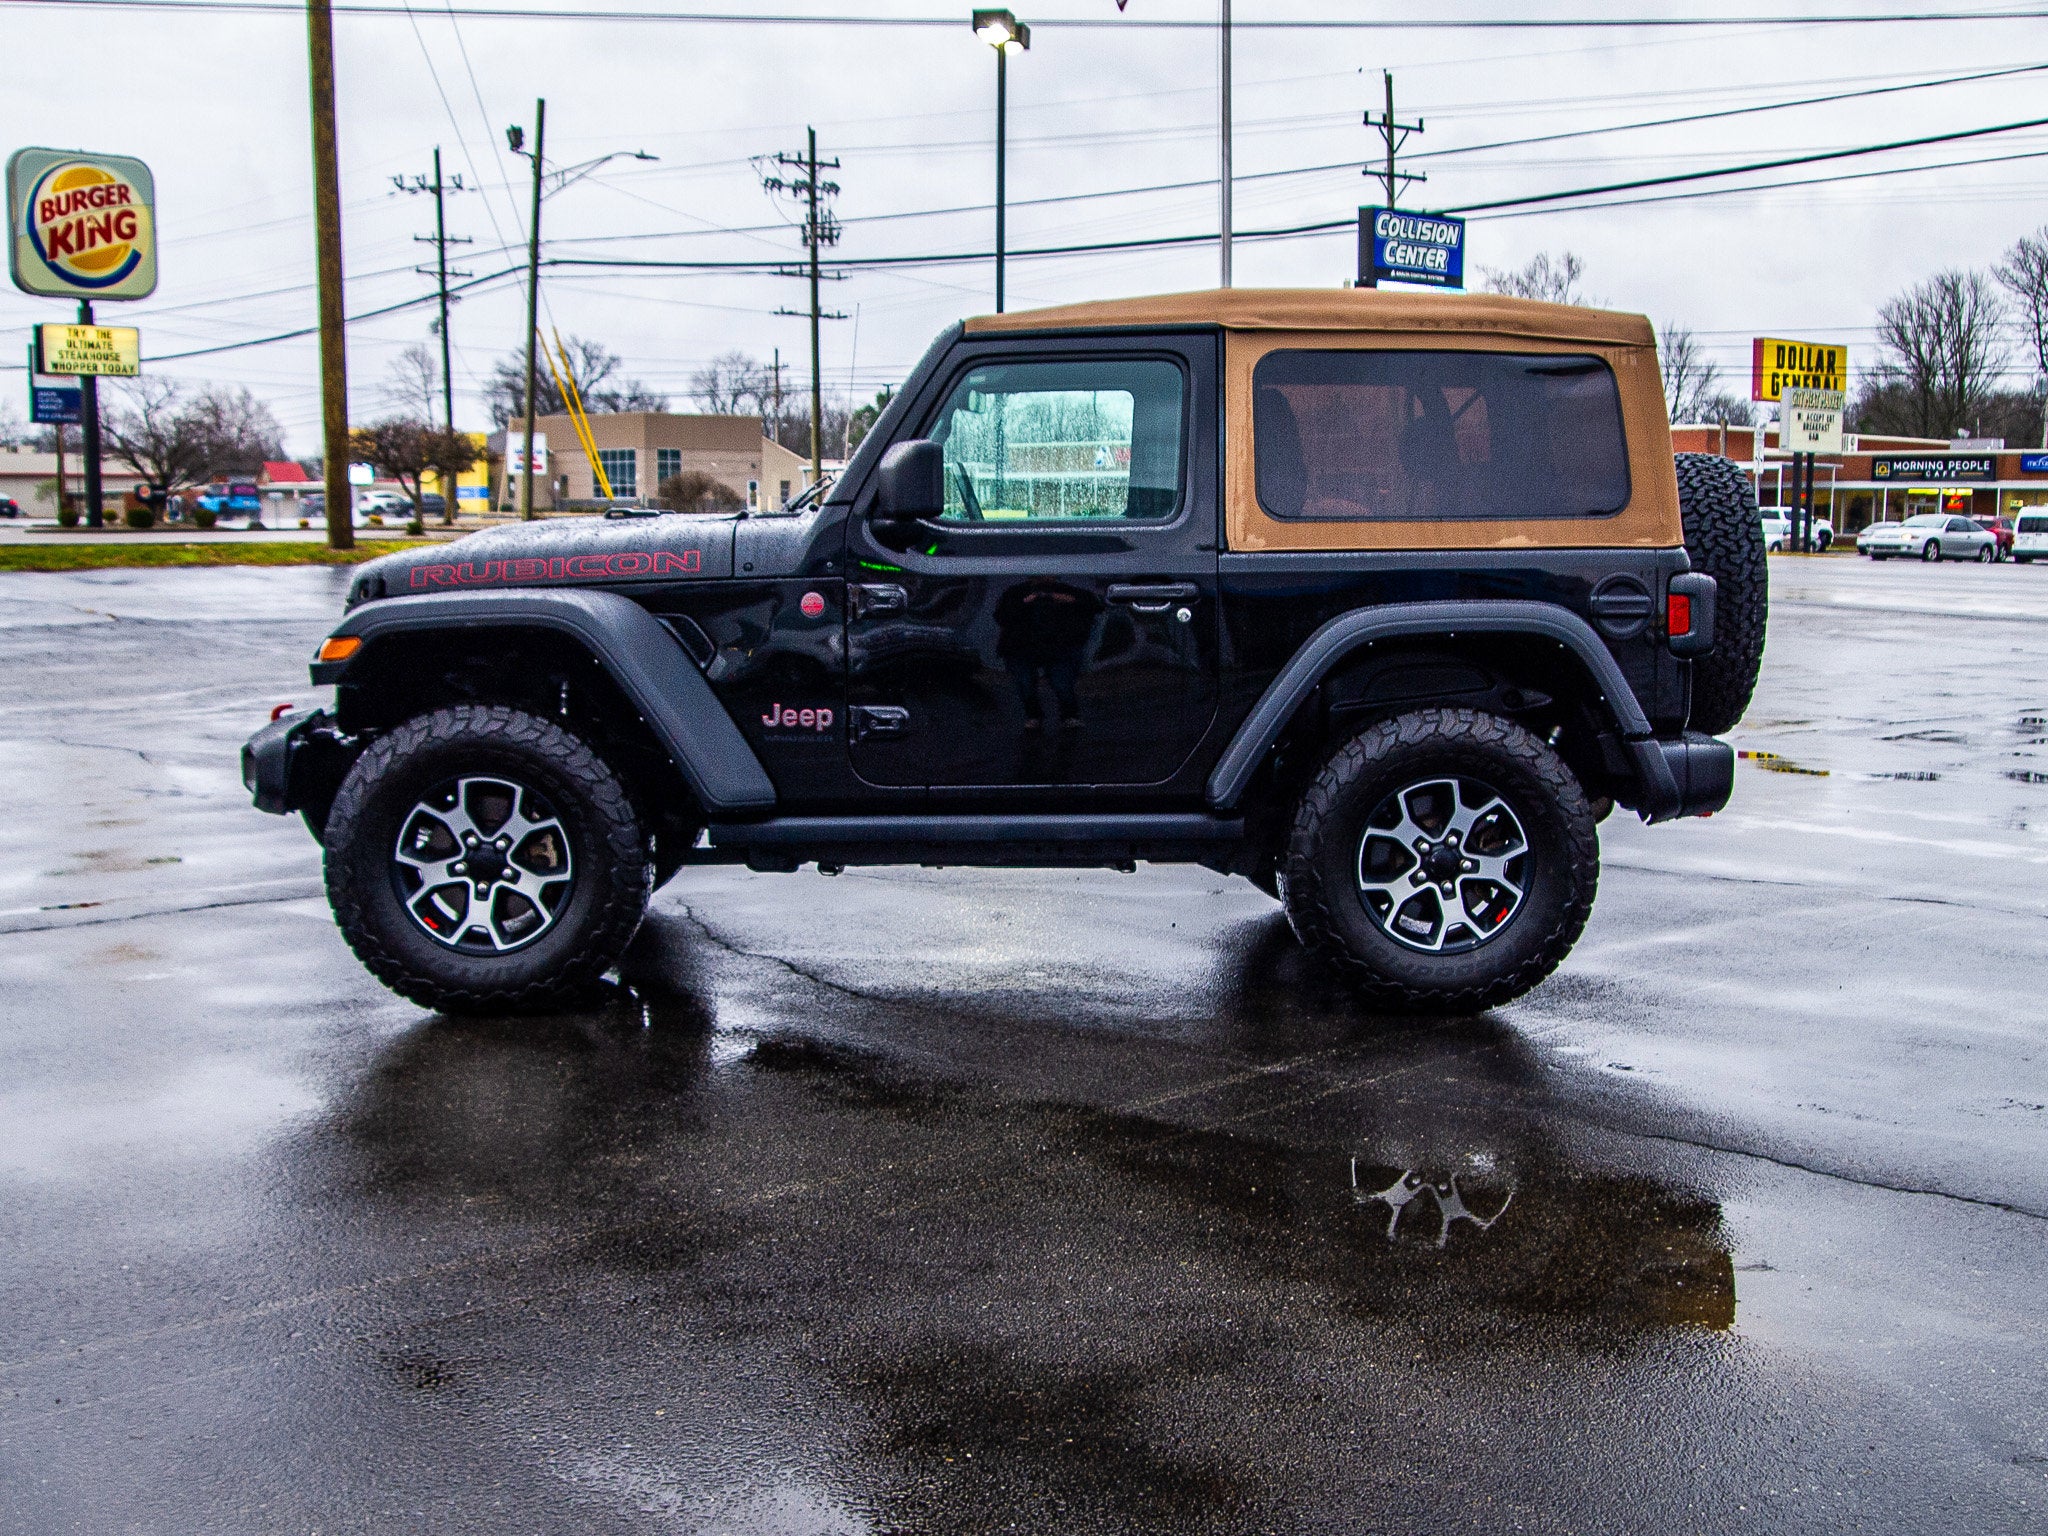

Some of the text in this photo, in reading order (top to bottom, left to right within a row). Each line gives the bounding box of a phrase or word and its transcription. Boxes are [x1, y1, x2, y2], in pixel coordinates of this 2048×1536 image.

[41, 184, 130, 223] BURGER
[48, 209, 136, 260] KING
[1376, 212, 1460, 246] COLLISION
[1384, 240, 1447, 269] CENTER
[66, 339, 113, 350] ULTIMATE
[67, 328, 112, 339] TRY THE
[51, 361, 135, 373] WHOPPER TODAY
[58, 350, 120, 361] STEAKHOUSE
[1776, 344, 1837, 374] DOLLAR
[1893, 460, 1991, 471] MORNING PEOPLE
[1925, 470, 1956, 478] CAFE
[410, 550, 702, 588] RUBICON
[761, 702, 834, 731] Jeep
